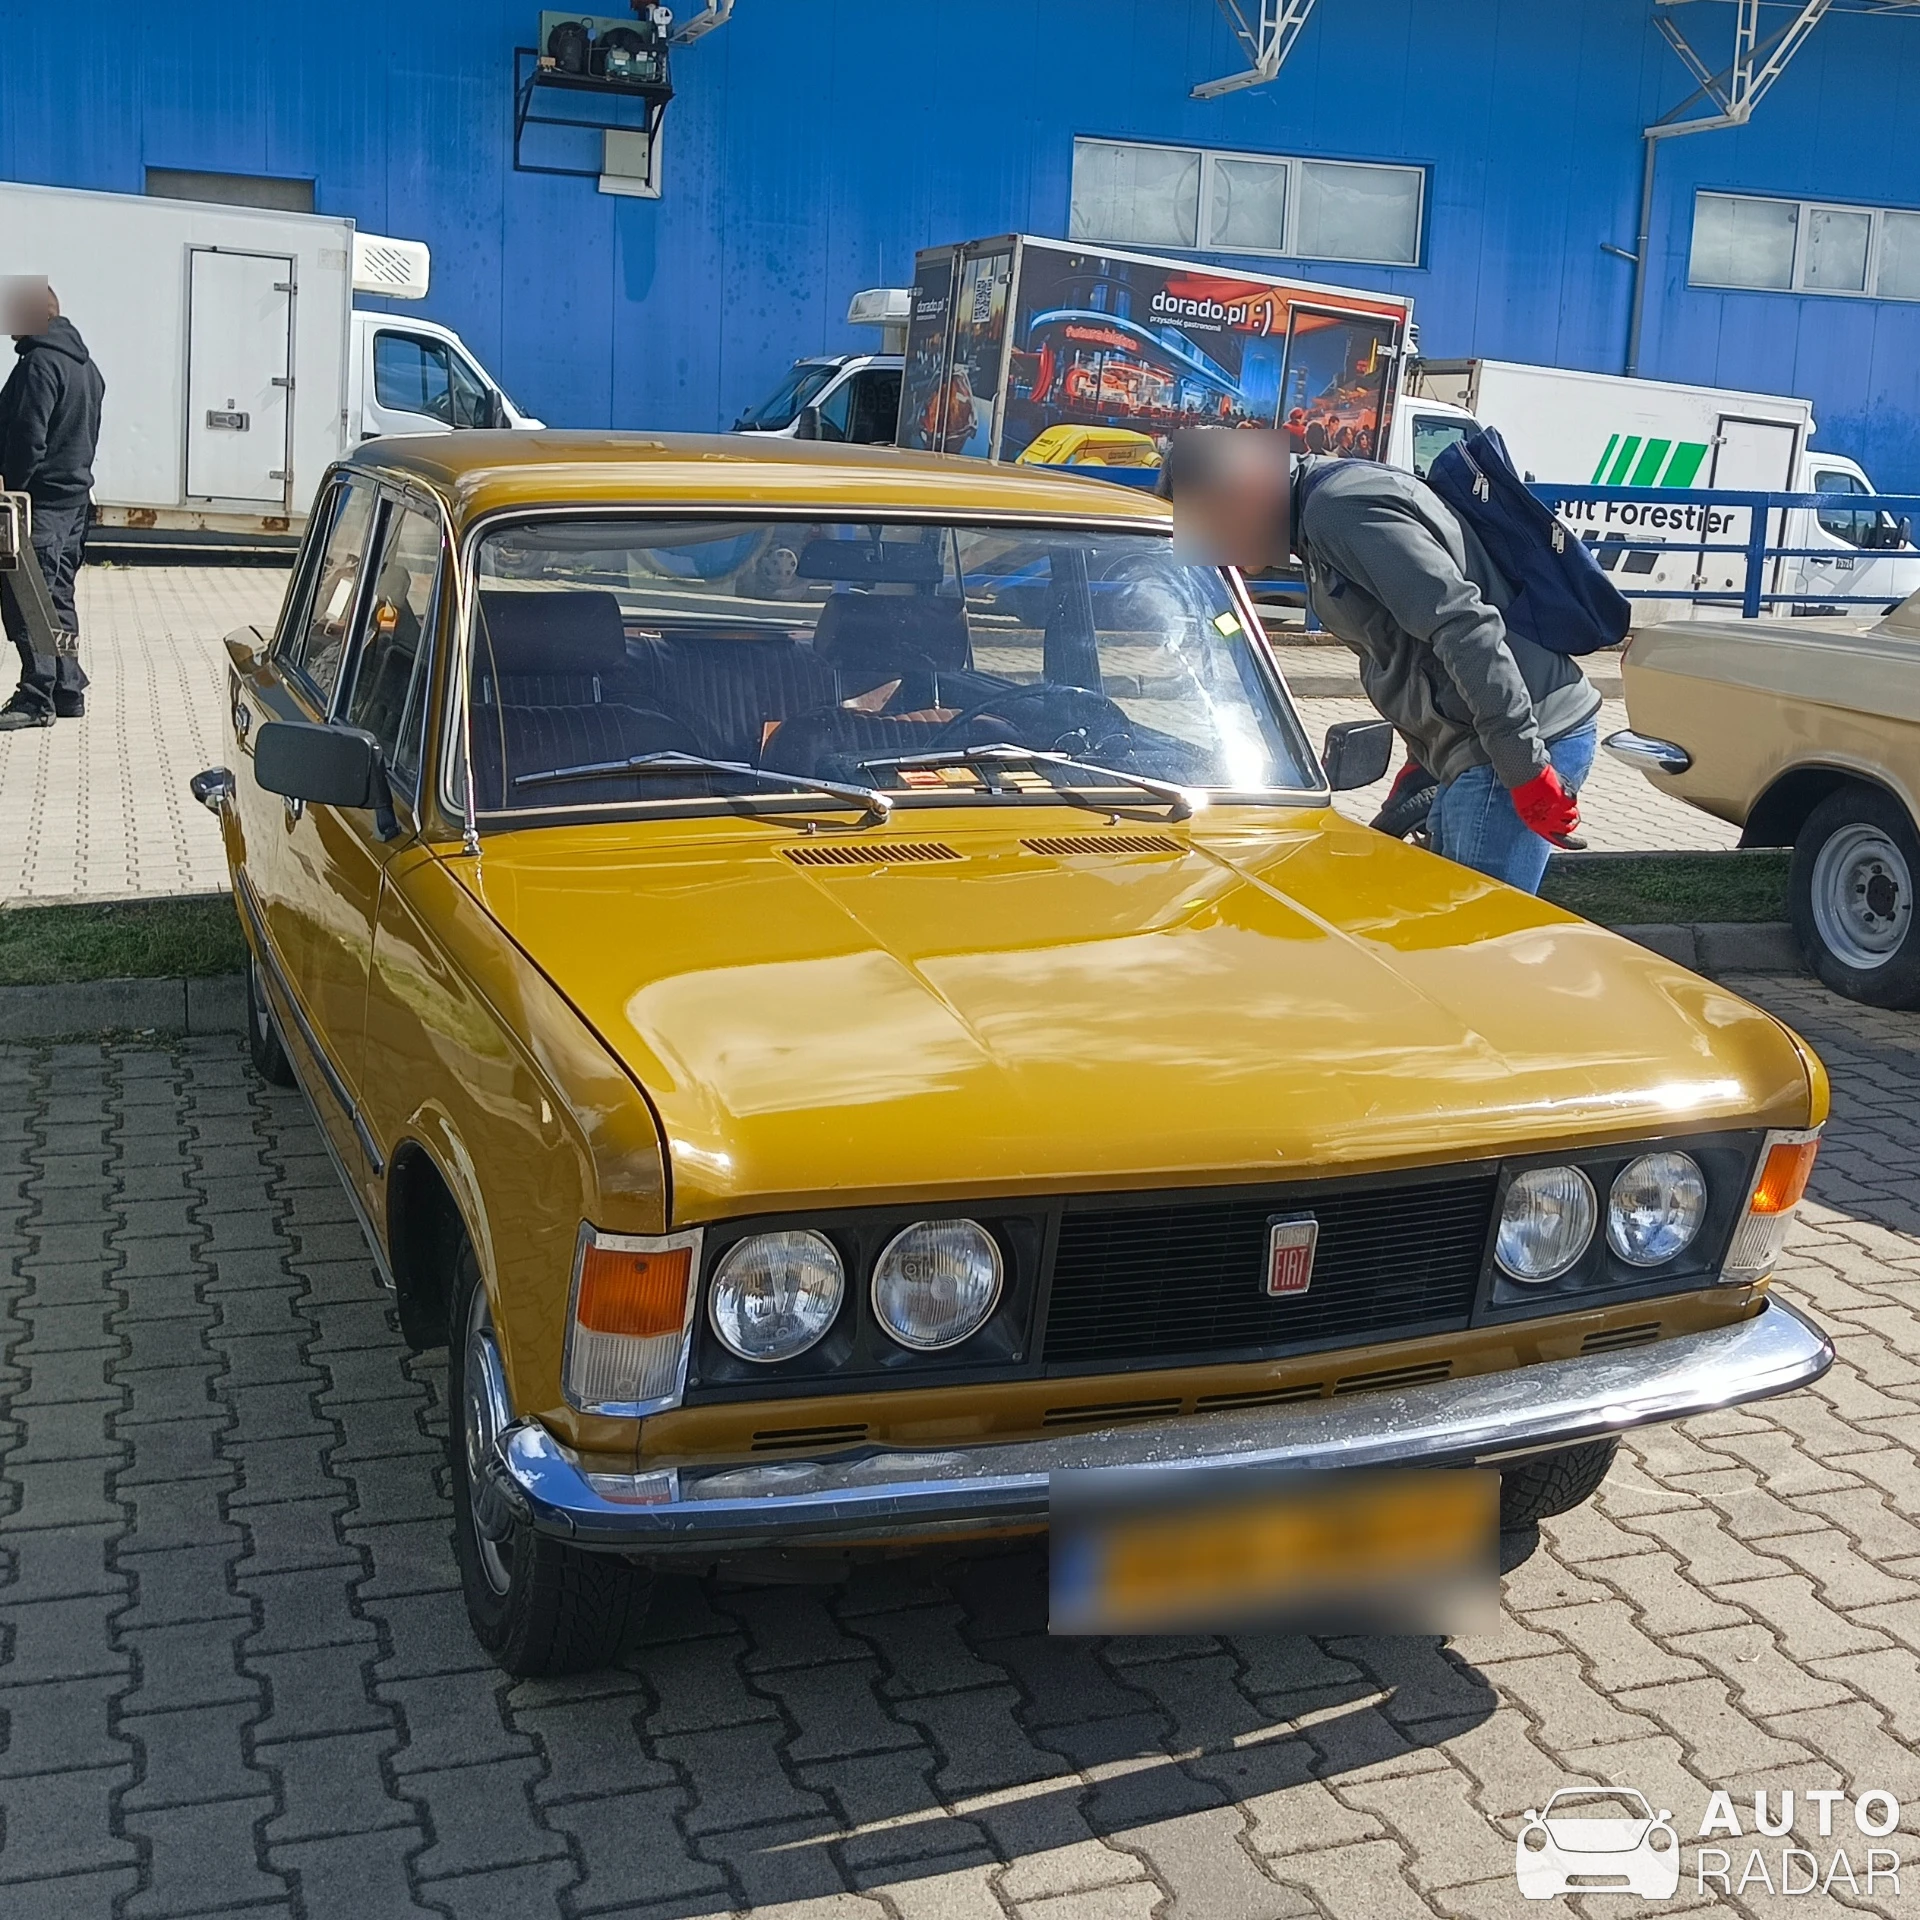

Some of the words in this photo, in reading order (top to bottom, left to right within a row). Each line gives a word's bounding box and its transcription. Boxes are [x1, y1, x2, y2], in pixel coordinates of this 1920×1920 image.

[1151, 290, 1247, 325] dorado.pl
[1605, 501, 1736, 535] Forestier
[1274, 1249, 1308, 1287] FIAT
